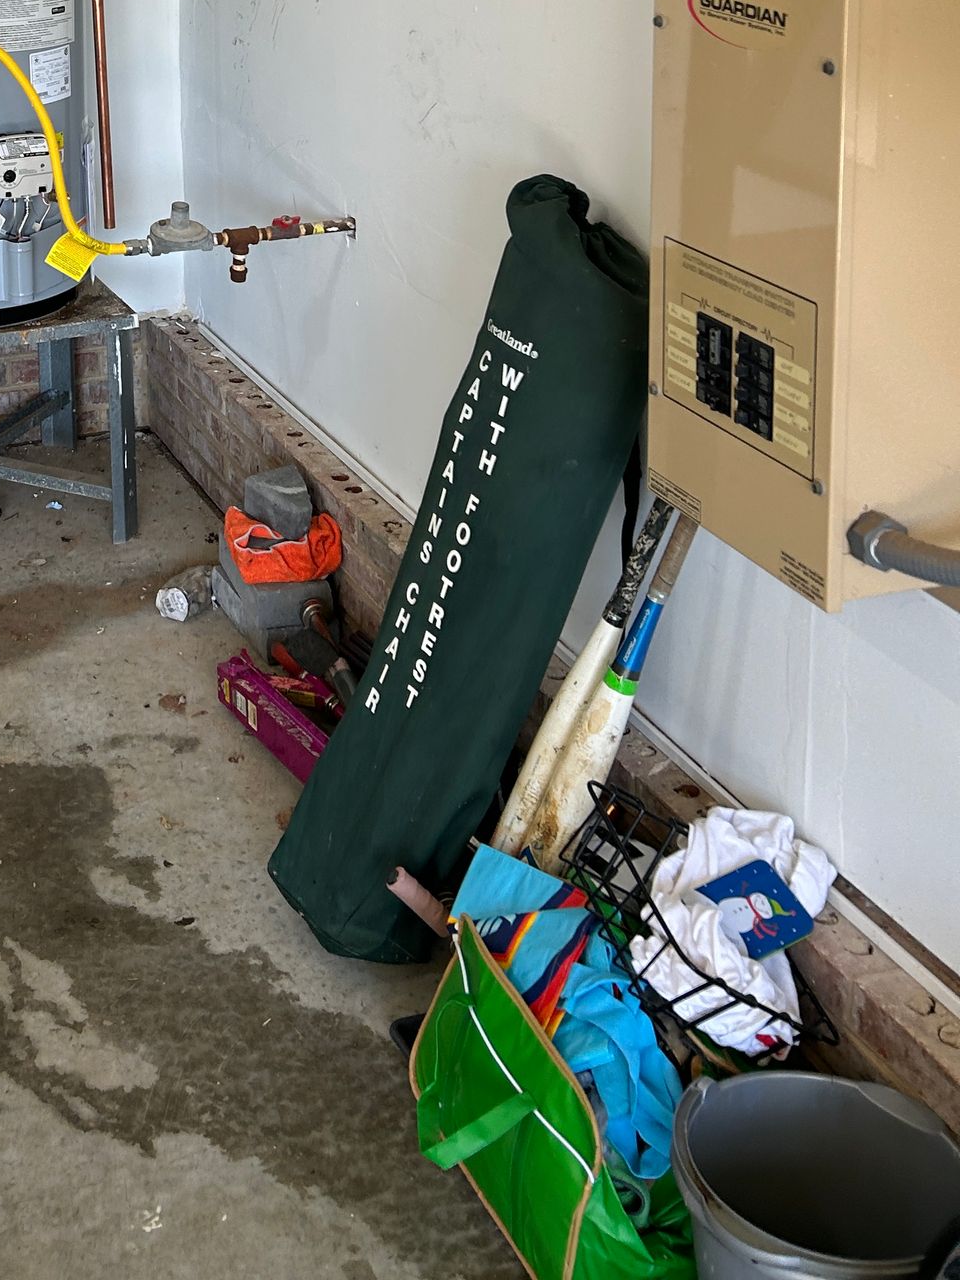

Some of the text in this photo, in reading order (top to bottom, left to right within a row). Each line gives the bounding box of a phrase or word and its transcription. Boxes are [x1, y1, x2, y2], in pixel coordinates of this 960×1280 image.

[365, 349, 492, 714] CAPTAINS CHAIR
[406, 363, 525, 709] WITH FOOTREST
